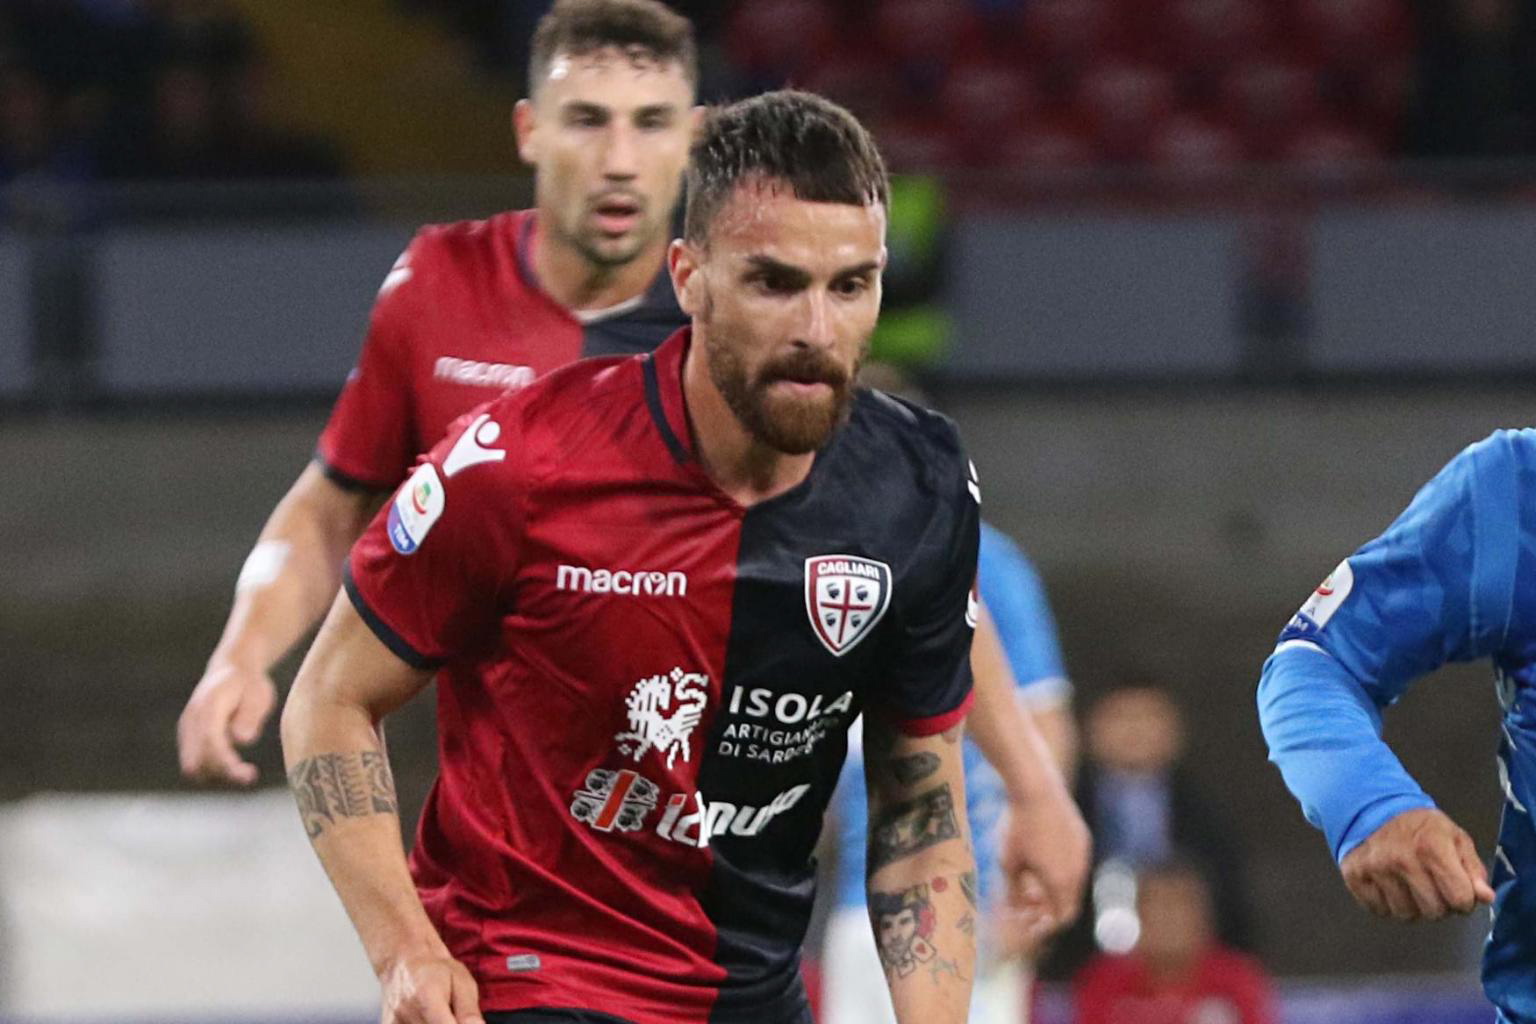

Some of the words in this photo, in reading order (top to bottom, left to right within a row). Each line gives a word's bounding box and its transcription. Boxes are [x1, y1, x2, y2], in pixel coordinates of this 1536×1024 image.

[556, 564, 687, 596] macron
[817, 561, 880, 580] CAGLIARI
[728, 685, 853, 724] ISOLA
[718, 741, 741, 758] DI
